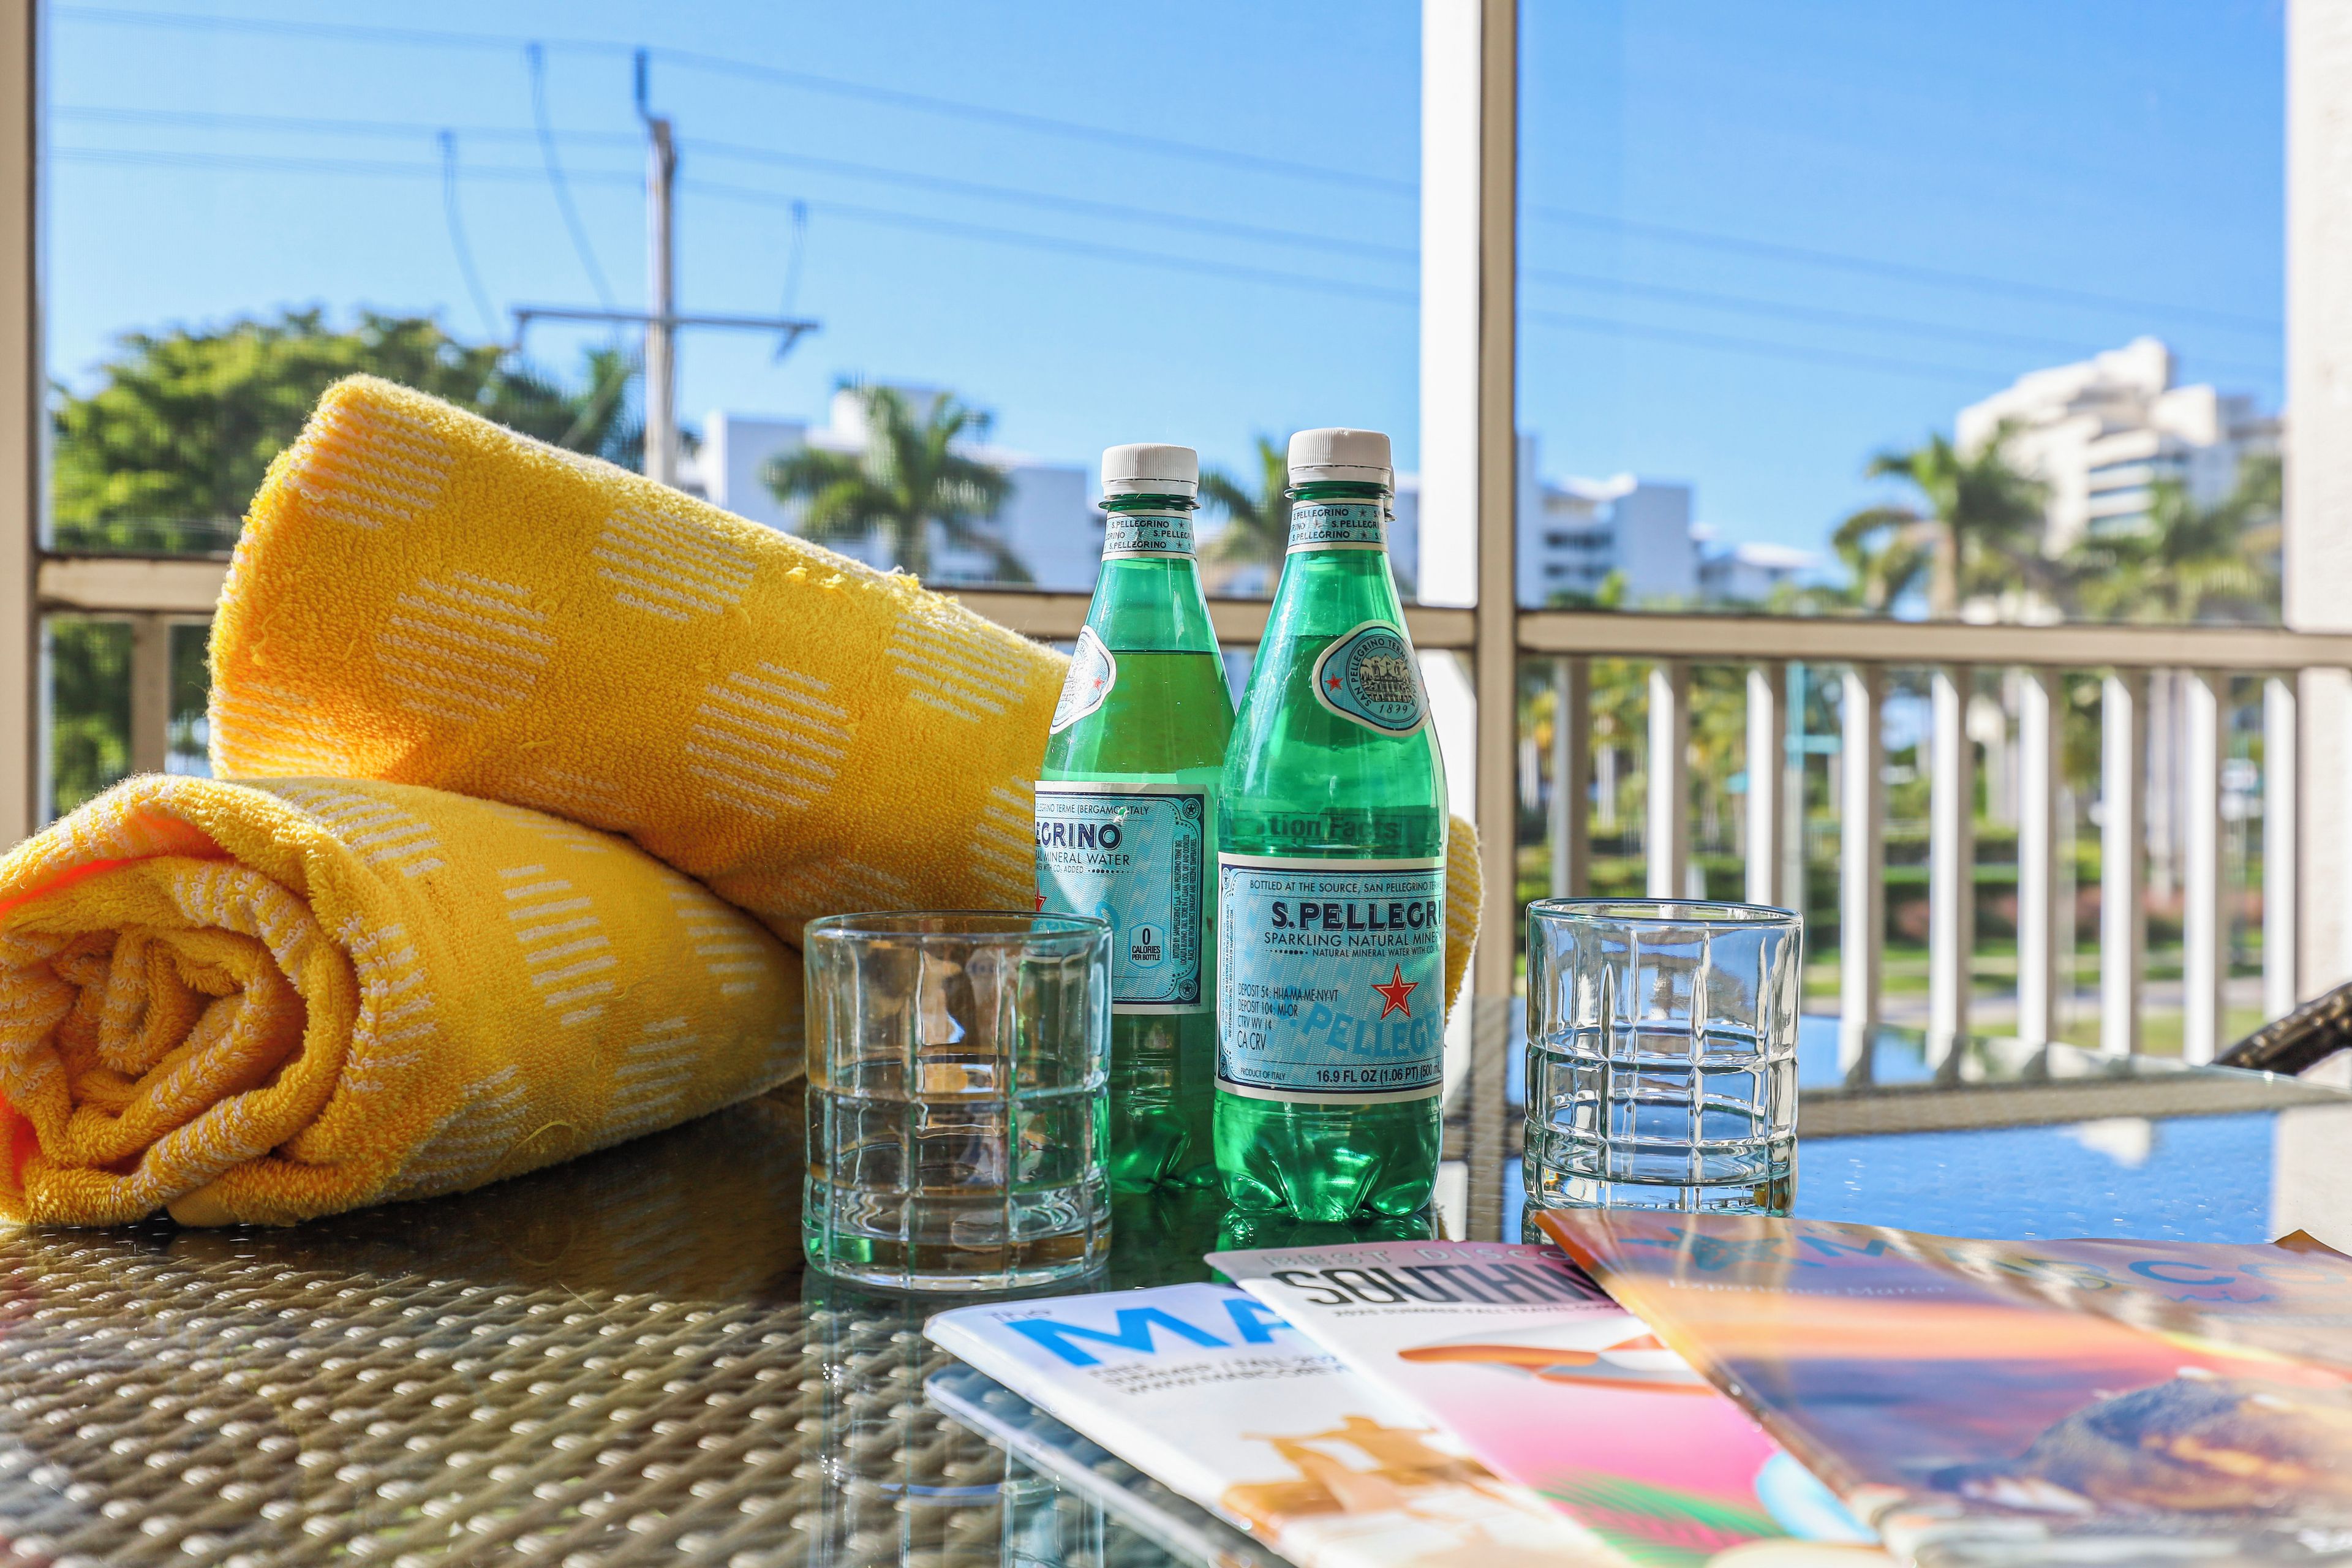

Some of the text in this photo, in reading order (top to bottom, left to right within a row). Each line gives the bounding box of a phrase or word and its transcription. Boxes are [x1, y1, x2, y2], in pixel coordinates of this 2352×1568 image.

[1350, 638, 1385, 682] PELLEGRINO
[1354, 687, 1371, 706] SAN
[1057, 804, 1075, 813] TERME
[1330, 816, 1403, 839] Facts
[1044, 851, 1082, 864] MINERAL
[1087, 854, 1130, 865] WATER
[1250, 880, 1282, 891] BOTTLED
[1285, 882, 1296, 891] AT
[1298, 882, 1316, 892] THE
[1319, 883, 1360, 894] SOURCE,
[1364, 884, 1383, 892] SAN
[1386, 881, 1428, 892] PELLEGRINO
[1142, 928, 1151, 945] 0
[1264, 932, 1342, 947] SPARKLING
[1349, 934, 1409, 947] NATURAL
[1313, 949, 1349, 957] NATURAL
[1388, 948, 1409, 957] WATER
[1411, 946, 1425, 955] WITH
[1238, 982, 1259, 997] DEPOSIT
[1238, 998, 1259, 1014] DEPOSIT
[1278, 1004, 1298, 1017] MI-OR
[1237, 1030, 1267, 1051] CA CRV
[1240, 1067, 1262, 1078] PRODUCT
[1271, 1072, 1286, 1080] ITALY
[1317, 1069, 1340, 1082] 16.9
[1343, 1069, 1358, 1082] FL
[1361, 1069, 1378, 1082] OZ
[1380, 1068, 1403, 1085] (1.06
[1405, 1066, 1419, 1082] PT)
[1420, 1063, 1433, 1080] (500
[1261, 1249, 1391, 1268] BEST
